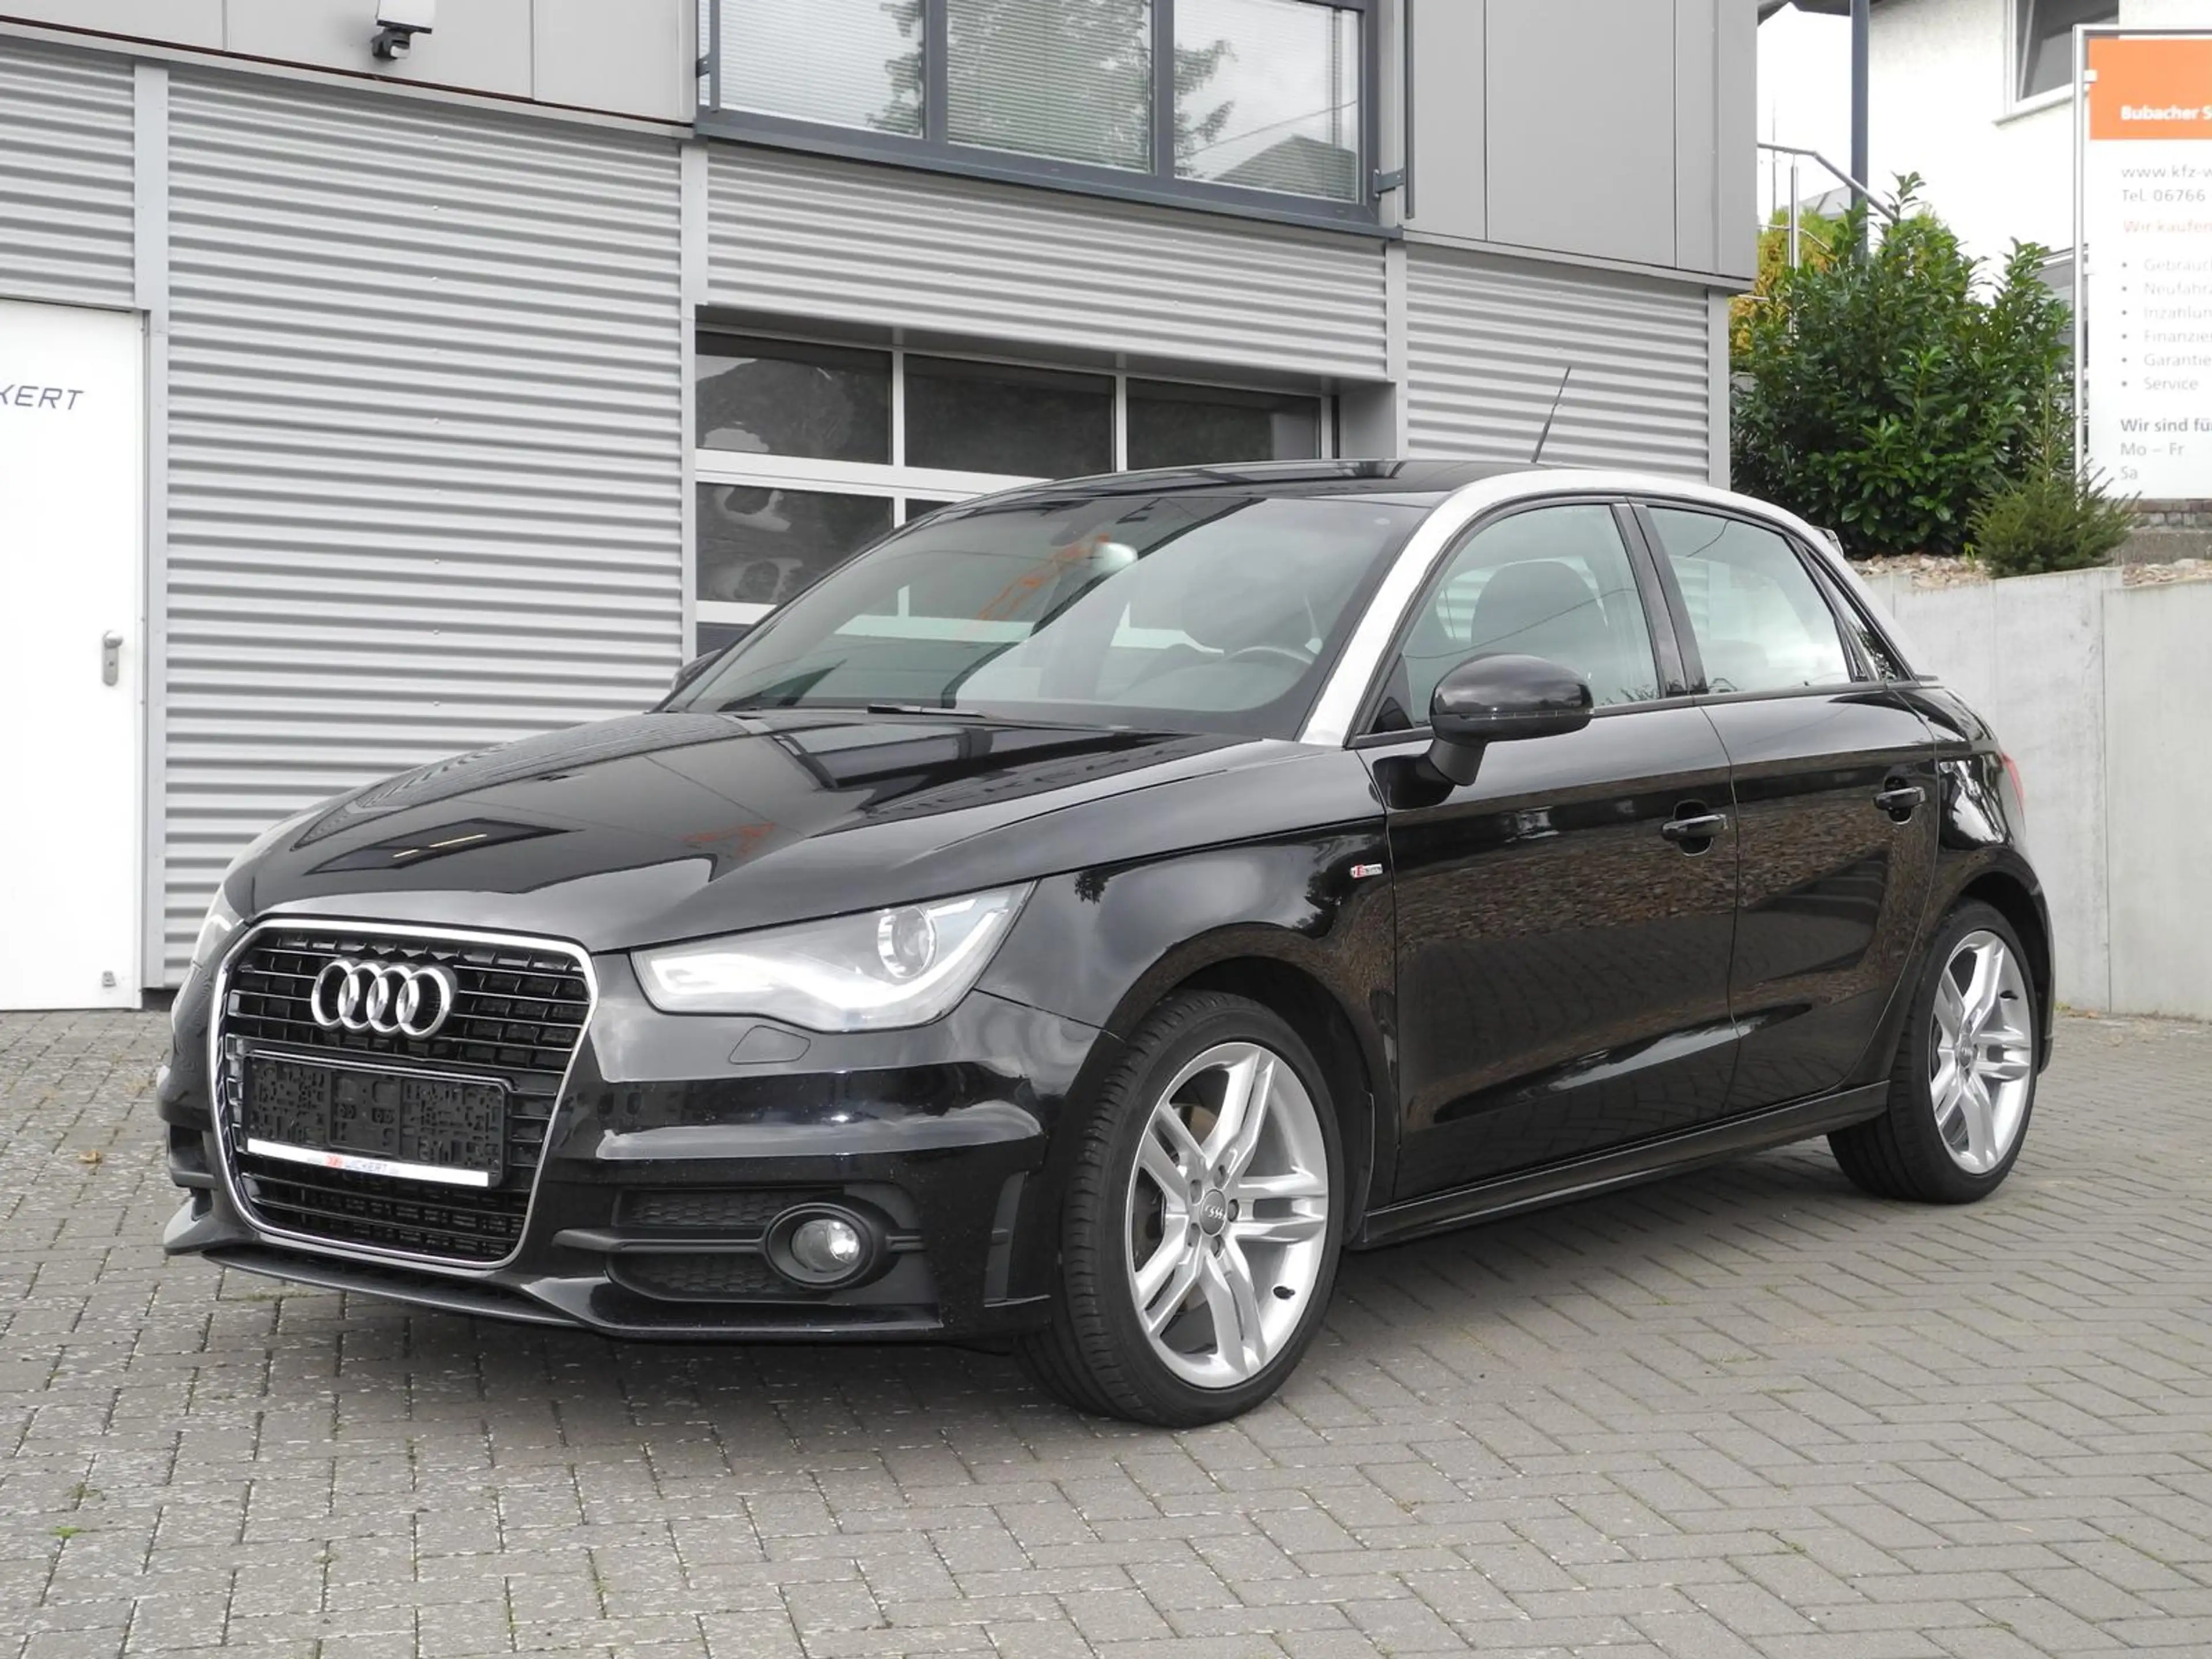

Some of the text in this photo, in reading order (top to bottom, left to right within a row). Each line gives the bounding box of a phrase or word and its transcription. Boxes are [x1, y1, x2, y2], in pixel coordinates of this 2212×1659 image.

[2122, 105, 2199, 120] Bubacher
[2153, 188, 2206, 202] 06766
[2123, 219, 2150, 233] Wir
[2143, 257, 2212, 272] Gebrauc
[2143, 376, 2199, 391] Service
[2120, 416, 2212, 432] Wir sind fü
[2120, 442, 2147, 456] Mo
[2169, 442, 2186, 456] Fr
[2120, 465, 2139, 481] Sa
